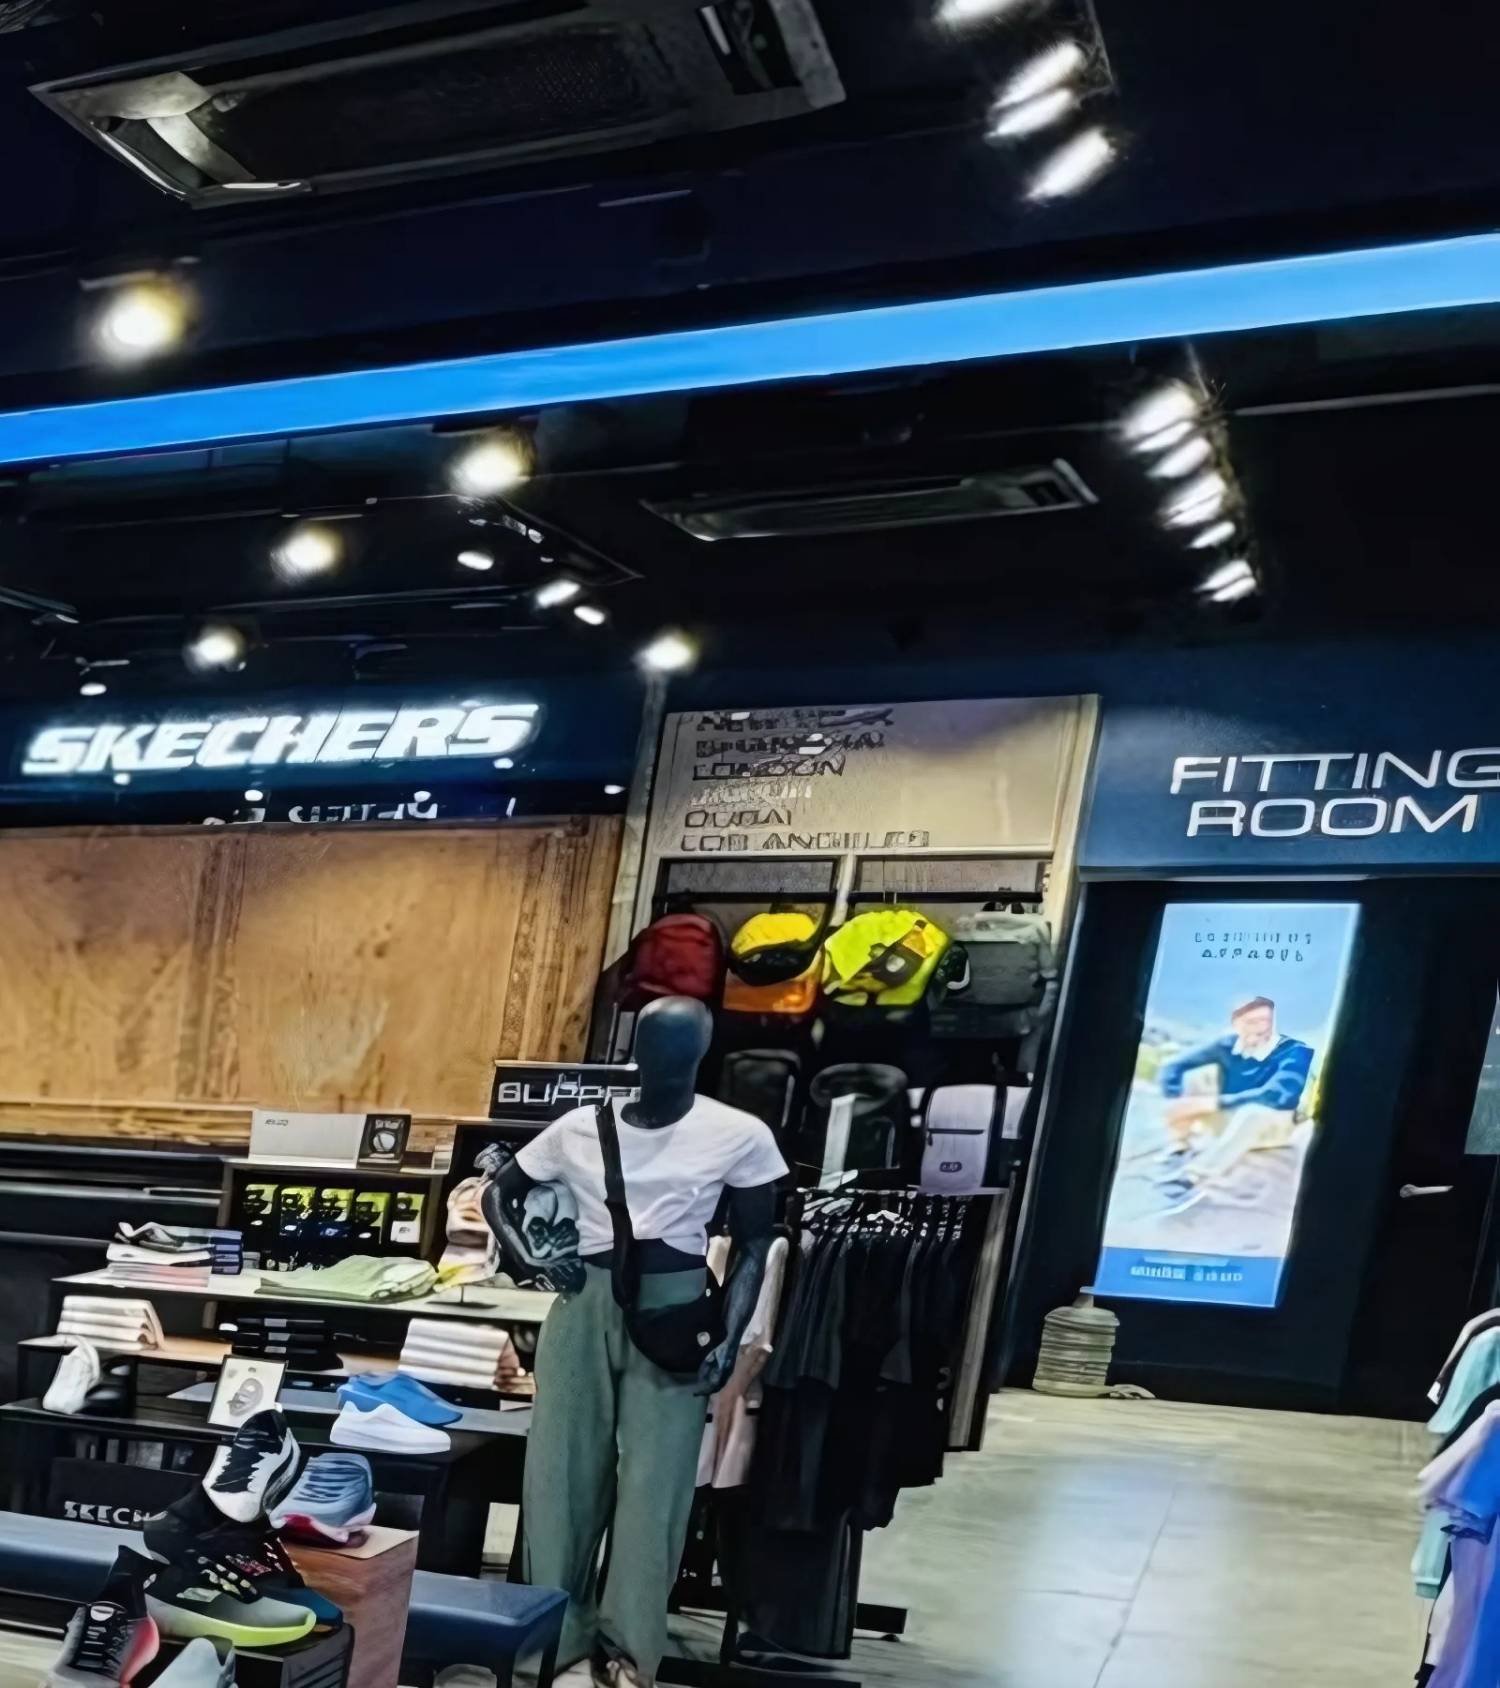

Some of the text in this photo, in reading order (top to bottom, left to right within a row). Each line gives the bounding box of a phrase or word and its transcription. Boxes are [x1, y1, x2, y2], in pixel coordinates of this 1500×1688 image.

[21, 703, 540, 775] SKECHERS
[691, 757, 846, 782] LONDON
[1169, 747, 1500, 795] FITTING
[1186, 794, 1479, 838] ROOM
[64, 1500, 155, 1526] SKECH
